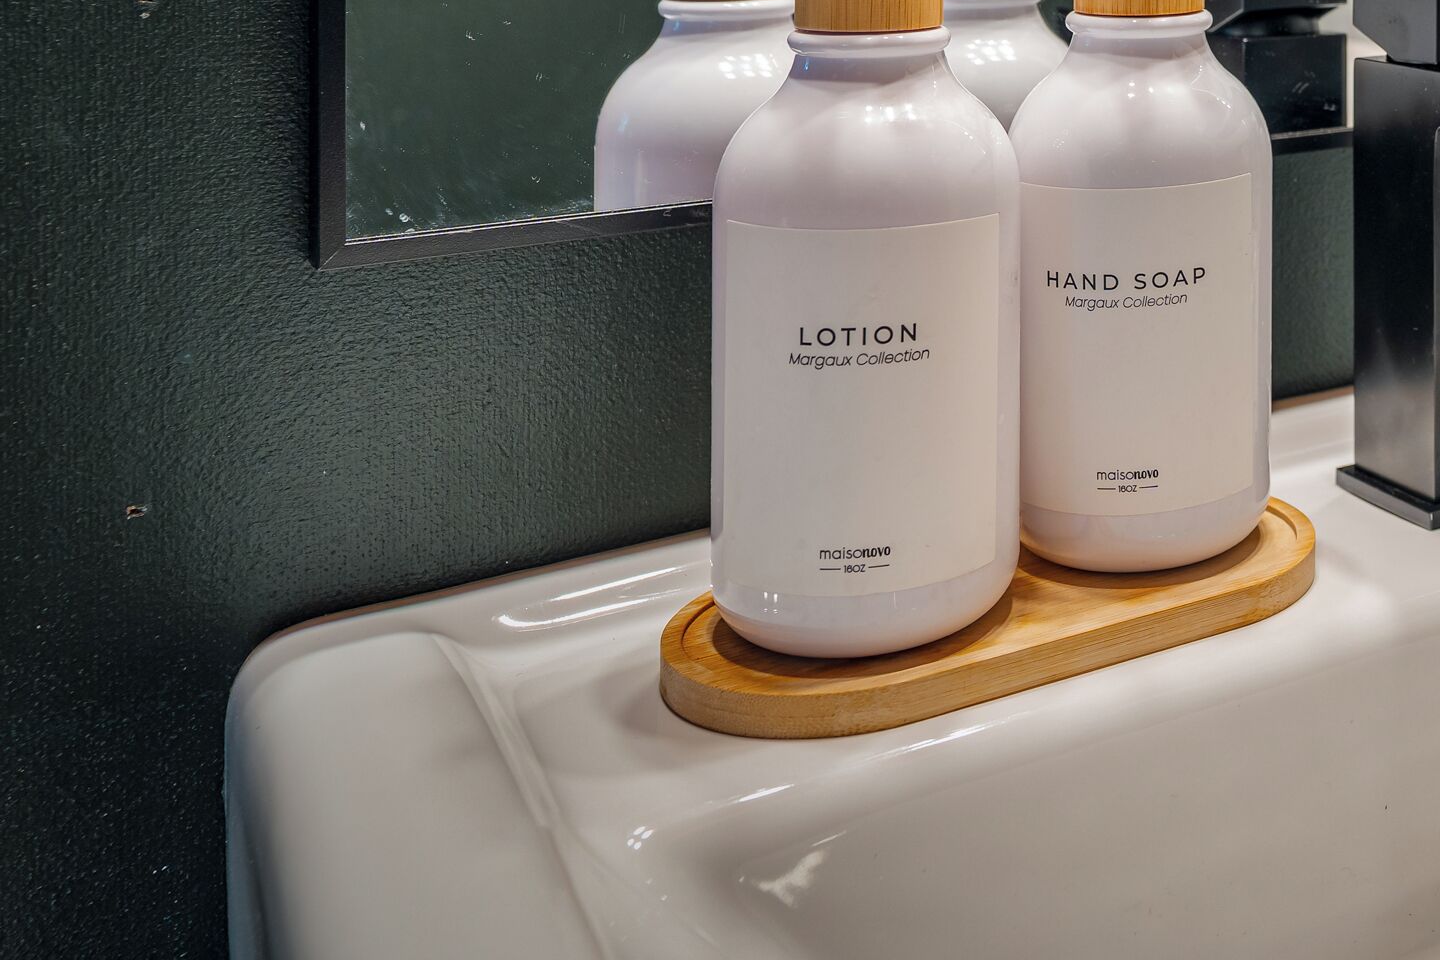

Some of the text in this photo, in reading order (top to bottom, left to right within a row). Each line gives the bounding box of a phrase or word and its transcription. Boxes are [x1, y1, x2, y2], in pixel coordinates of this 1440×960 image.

[1046, 267, 1207, 291] HAND SOAP
[1064, 293, 1188, 312] Margaux Collection
[799, 323, 917, 347] LOTION
[788, 348, 931, 370] Margaux Collection
[1096, 469, 1159, 481] maisonovo
[819, 546, 891, 560] maisonovo
